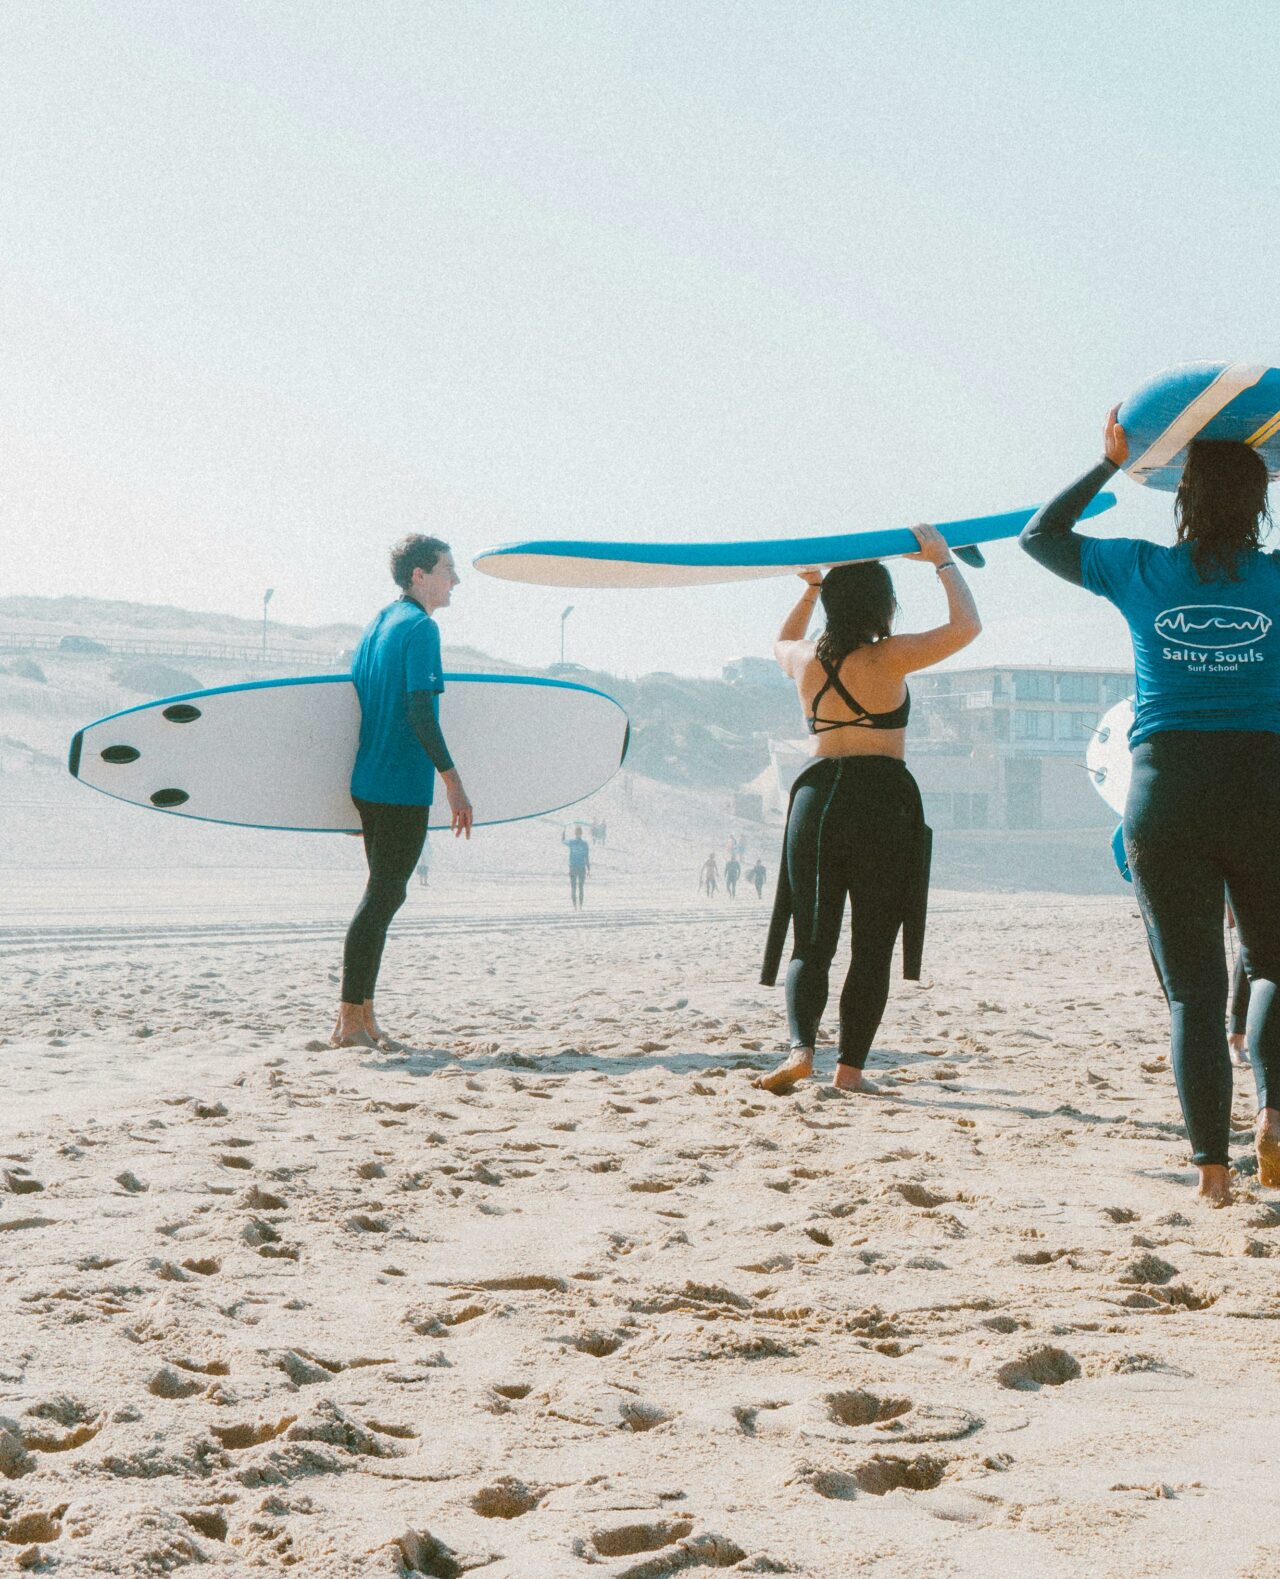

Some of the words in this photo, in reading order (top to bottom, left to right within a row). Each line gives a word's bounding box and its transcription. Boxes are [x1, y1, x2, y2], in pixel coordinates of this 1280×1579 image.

[1162, 647, 1208, 662] Salty
[1214, 648, 1264, 663] Souls
[1187, 664, 1206, 672] Surf
[1208, 664, 1238, 672] School
